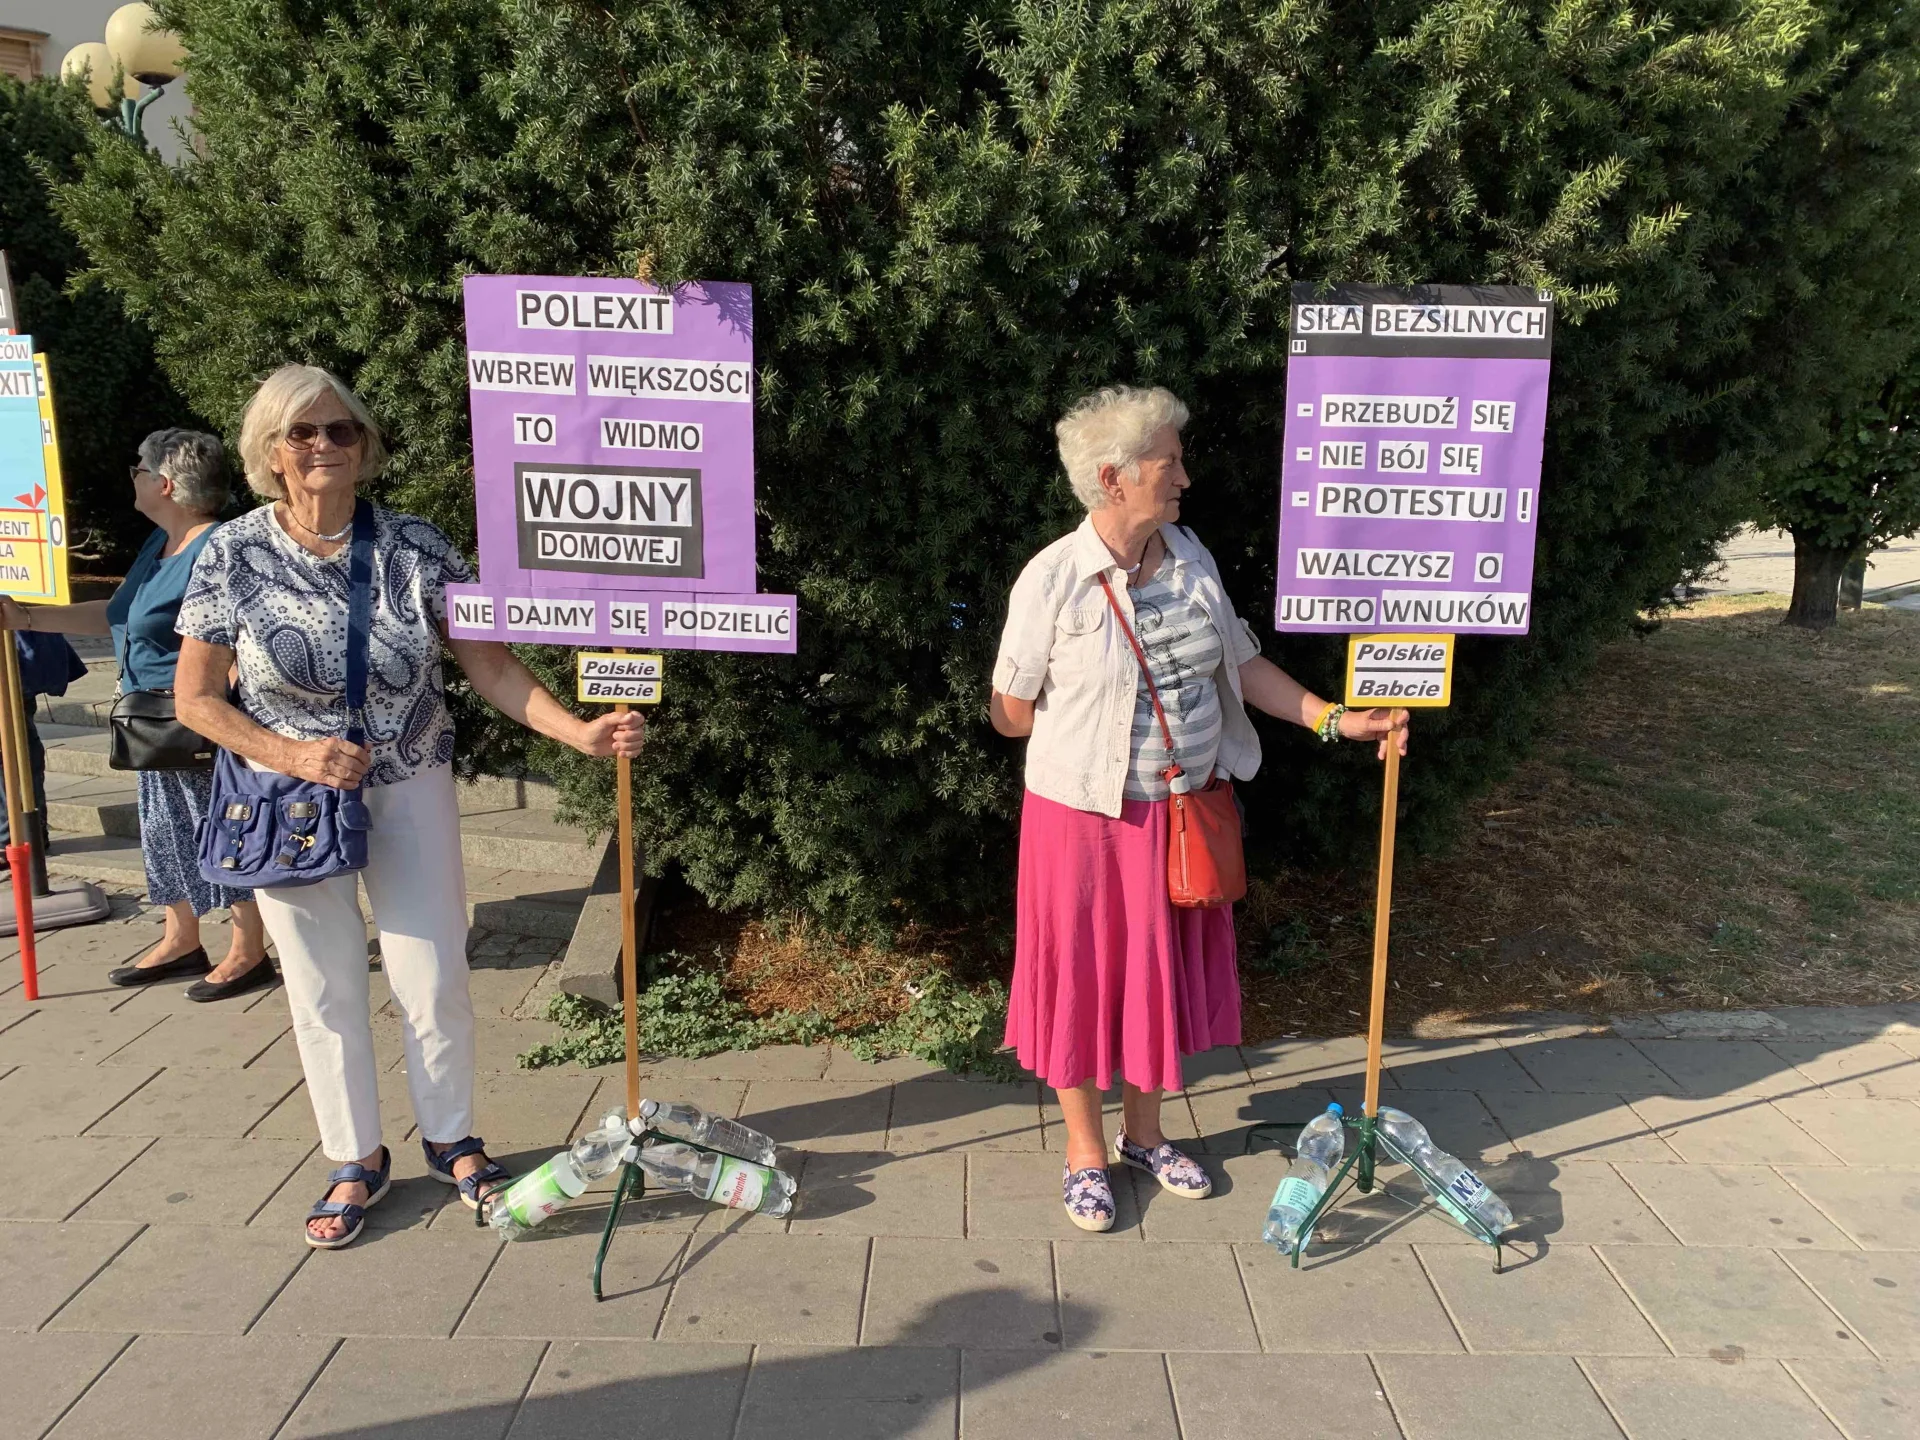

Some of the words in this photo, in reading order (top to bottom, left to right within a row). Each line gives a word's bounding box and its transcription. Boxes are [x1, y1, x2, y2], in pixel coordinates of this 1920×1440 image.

[522, 293, 670, 331] POLEXIT
[1300, 307, 1361, 331] SIŁA
[1375, 308, 1544, 336] BEZSILNYCH
[471, 359, 574, 388] WBREW
[589, 363, 750, 396] WIĘKSZOŚCI
[1325, 397, 1456, 425] PRZEBUDŹ
[1474, 404, 1511, 430] SIĘ
[517, 417, 553, 442] TO
[604, 421, 700, 451] WIDMO
[1322, 446, 1364, 466] NIE
[1380, 443, 1425, 469] BÓJ
[1443, 447, 1479, 472] SIĘ
[525, 478, 687, 522] WOJNY
[1322, 486, 1503, 519] PROTESTUJ
[541, 533, 679, 565] DOMOWEJ
[1301, 551, 1452, 579] WALCZYSZ
[1479, 555, 1500, 580] O
[454, 602, 493, 624] NIE
[508, 605, 595, 627] DAJMY
[611, 609, 647, 634] SIĘ
[664, 609, 789, 635] PODZIELIĆ
[1281, 599, 1375, 623] JUTRO
[1382, 594, 1527, 625] WNUKÓW
[584, 660, 655, 676] Polskie
[1356, 643, 1445, 662] Polskie
[587, 682, 654, 698] Babcie
[1356, 679, 1440, 697] Babcie
